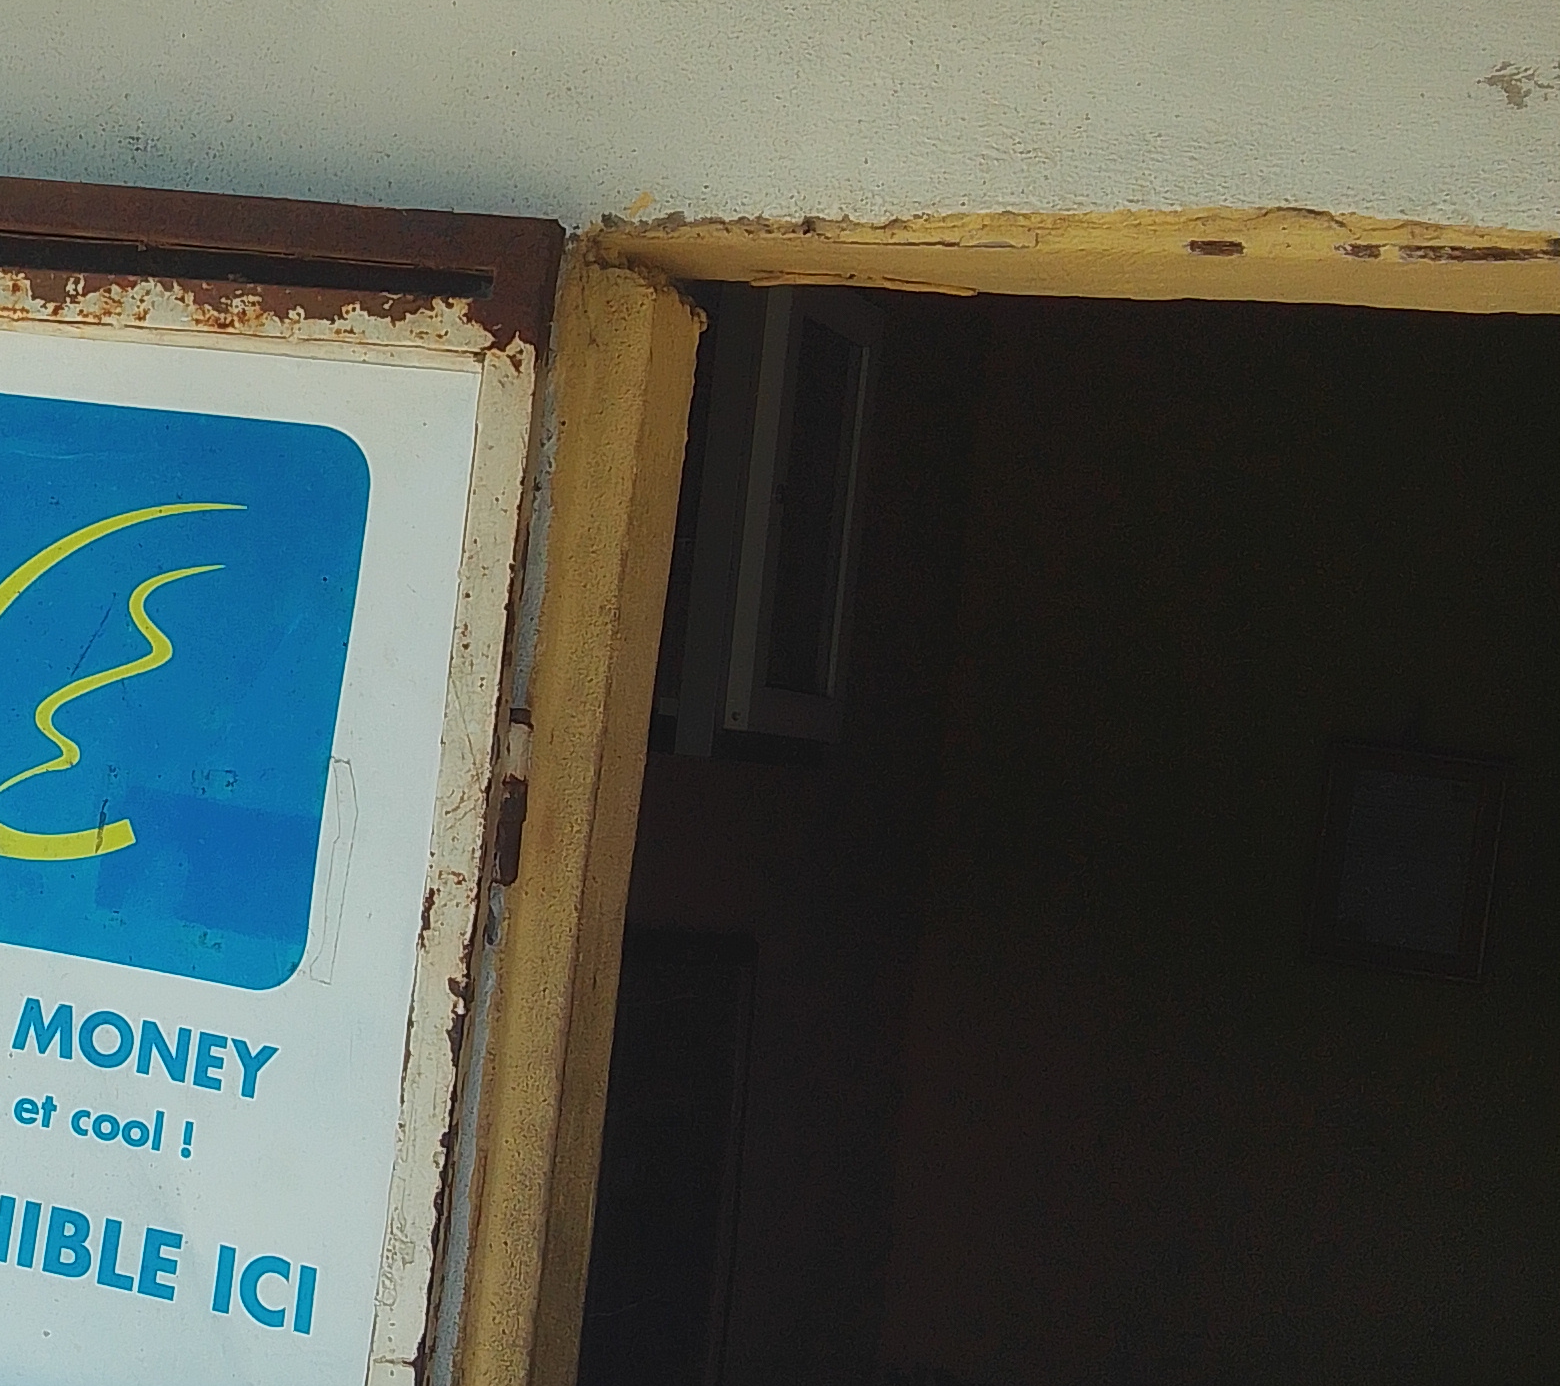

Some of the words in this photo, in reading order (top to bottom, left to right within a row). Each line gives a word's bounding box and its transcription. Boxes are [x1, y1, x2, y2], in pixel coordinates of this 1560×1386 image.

[12, 997, 280, 1099] MONEY
[13, 1096, 58, 1128] et
[71, 1110, 166, 1152] cool
[180, 1120, 194, 1158] !
[211, 1244, 318, 1335] ICI
